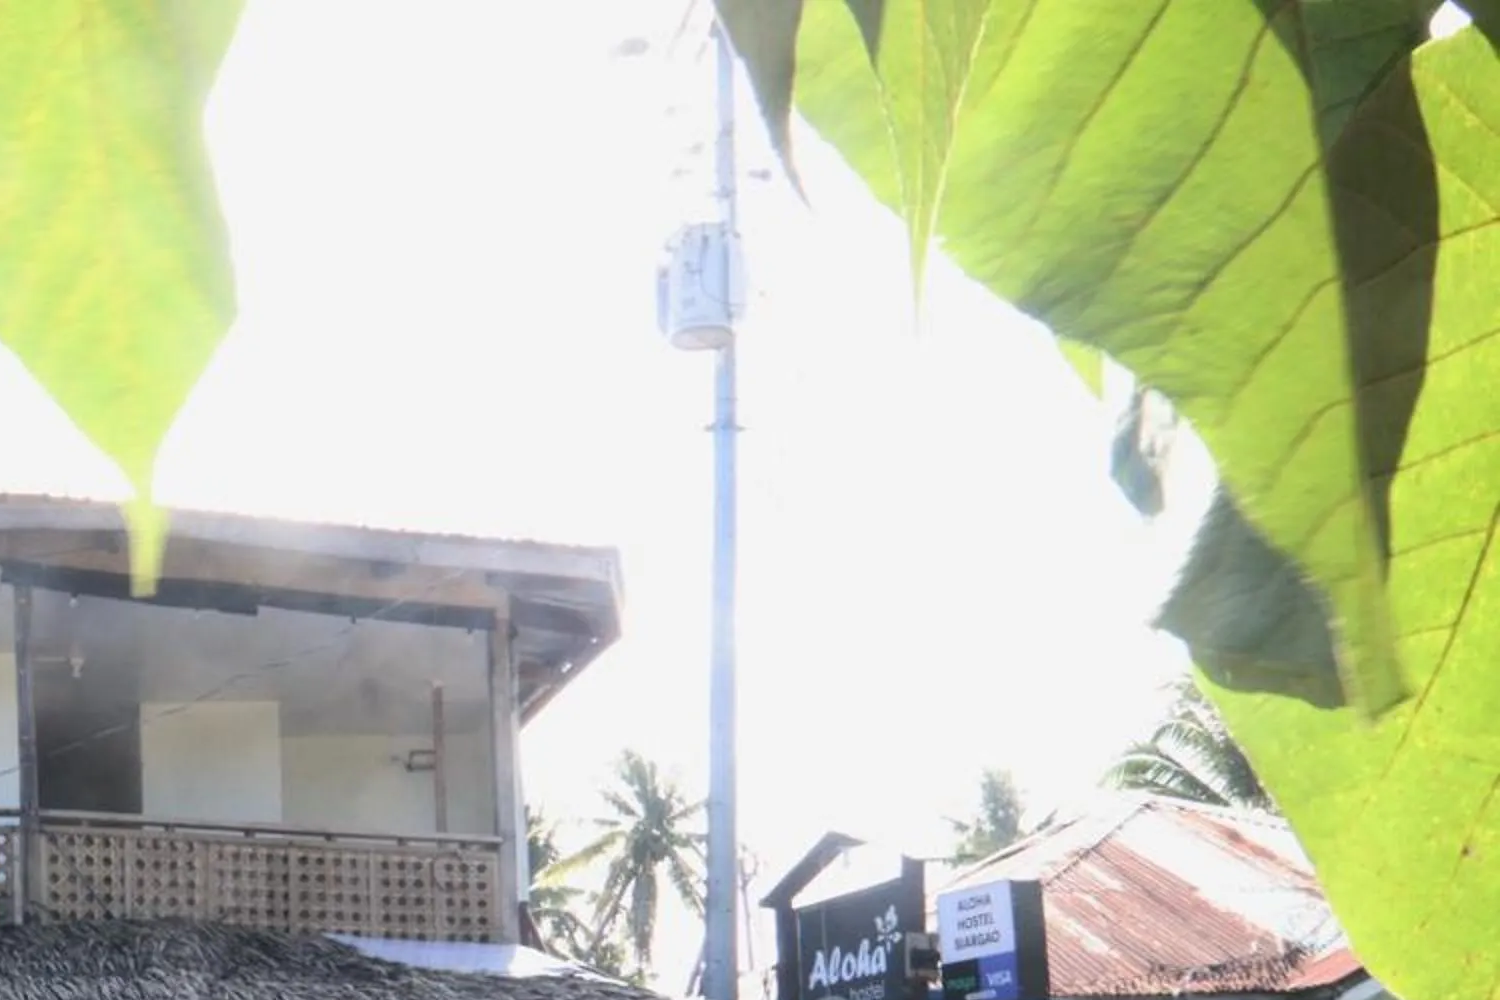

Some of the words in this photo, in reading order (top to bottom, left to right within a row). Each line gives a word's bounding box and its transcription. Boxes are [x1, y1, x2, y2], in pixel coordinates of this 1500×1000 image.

[956, 893, 992, 911] ALOHA
[956, 911, 996, 931] HOSTEL
[953, 930, 1001, 951] SIARGAO
[808, 937, 887, 991] Aloha
[985, 970, 1013, 987] VISA
